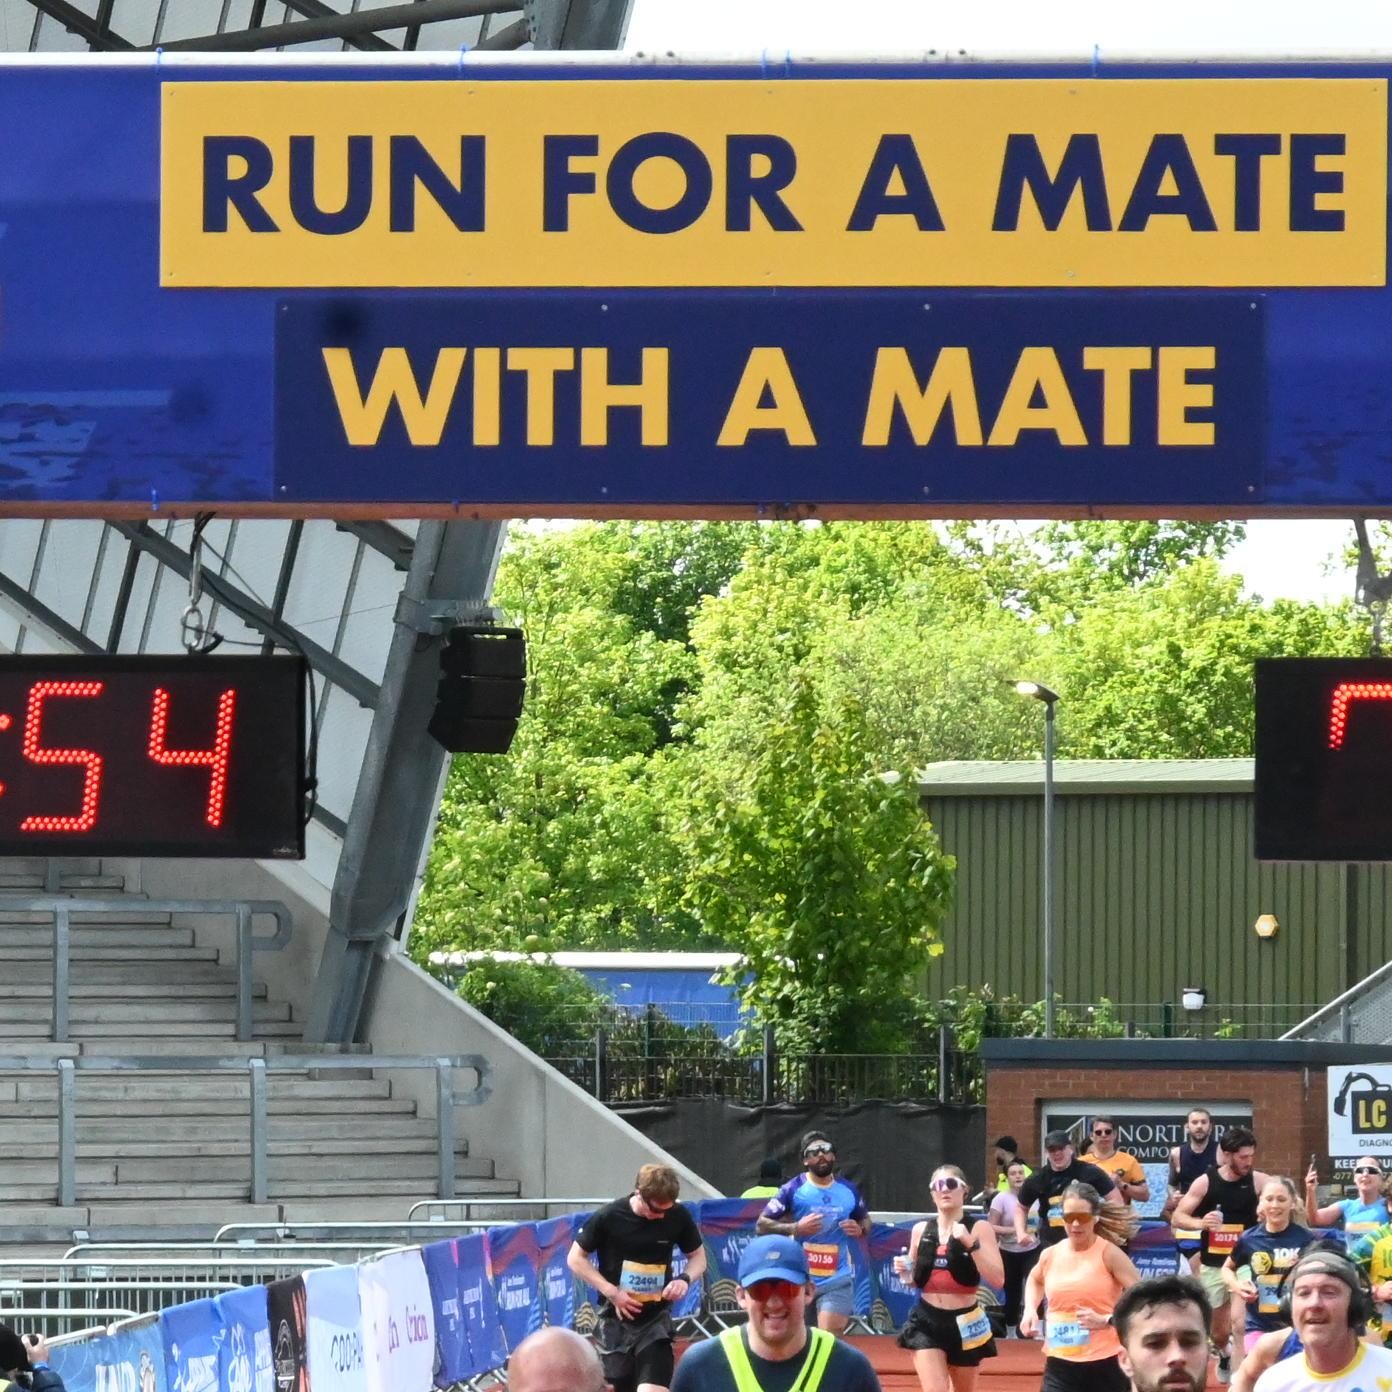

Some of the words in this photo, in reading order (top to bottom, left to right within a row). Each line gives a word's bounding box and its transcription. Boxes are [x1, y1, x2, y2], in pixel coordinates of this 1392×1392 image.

[202, 133, 487, 235] RUN
[543, 131, 805, 235] FOR
[845, 133, 945, 232] A
[992, 132, 1346, 233] MATE
[322, 345, 670, 447] WITH
[716, 347, 817, 447] A
[860, 346, 1216, 447] MATE
[1359, 1099, 1386, 1128] LC
